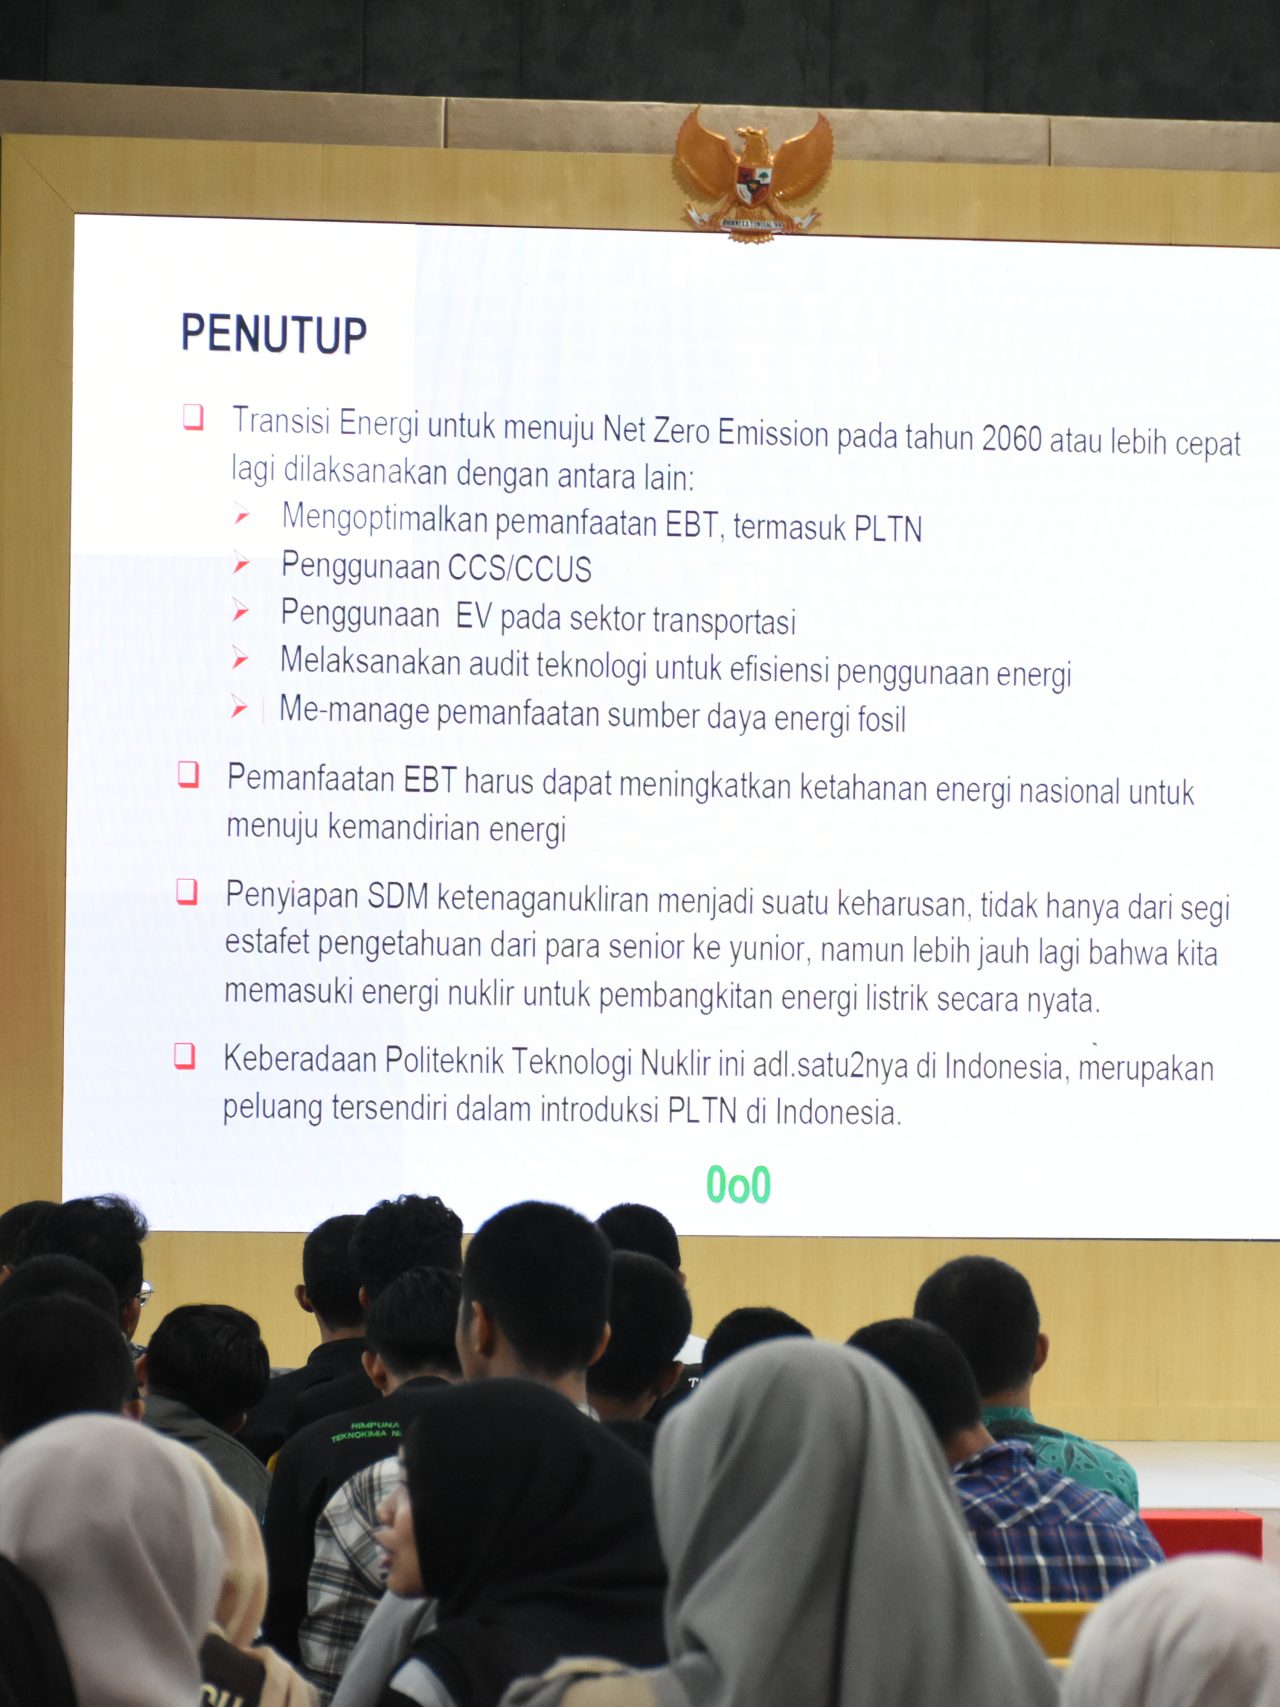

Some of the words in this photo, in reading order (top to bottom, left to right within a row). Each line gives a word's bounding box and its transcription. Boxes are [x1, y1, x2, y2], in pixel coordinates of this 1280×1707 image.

[182, 312, 368, 355] PENUTUP
[232, 404, 329, 434] Transisi
[340, 407, 419, 444] Energi
[428, 410, 496, 439] untuk
[504, 413, 594, 449] menuju
[604, 413, 646, 443] Net
[653, 415, 710, 444] Zero
[719, 416, 829, 448] Emission
[838, 421, 898, 456] pada
[905, 422, 973, 451] tahun
[982, 423, 1042, 452] 2060
[1050, 427, 1102, 454] atau
[1111, 426, 1167, 455] lebih
[1175, 431, 1241, 464] cepat
[232, 452, 275, 488] lagi
[284, 454, 447, 486] dilaksanakan
[456, 458, 549, 494] dengan
[557, 462, 636, 490] antara
[644, 462, 694, 492] lain:
[283, 500, 488, 537] Mengoptimalkan
[495, 507, 657, 541] pemanfaatan
[666, 509, 725, 543] EBT,
[733, 512, 847, 541] termasuk
[855, 514, 922, 543] PLTN
[282, 548, 440, 586] Penggunaan
[448, 552, 592, 584] CCS/CCUS
[282, 596, 440, 634] Penggunaan
[456, 600, 493, 629] EV
[501, 602, 561, 637] pada
[570, 603, 647, 632] sektor
[652, 606, 796, 641] transportasi
[281, 644, 461, 676] Melaksanakan
[469, 649, 530, 677] audit
[536, 649, 647, 687] teknologi
[656, 653, 722, 681] untuk
[730, 654, 829, 683] efisiensi
[837, 663, 989, 692] penggunaan
[996, 660, 1071, 695] energi
[280, 693, 430, 731] Me-manage
[437, 698, 600, 731] pemanfaatan
[607, 700, 701, 729] sumber
[707, 701, 766, 737] daya
[774, 703, 850, 739] energi
[857, 704, 906, 733] fosil
[228, 761, 395, 792] Pemanfaatan
[404, 764, 458, 794] EBT
[465, 765, 534, 795] harus
[542, 767, 612, 803] dapat
[620, 769, 791, 805] meningkatkan
[800, 771, 927, 801] ketahanan
[936, 775, 1011, 810] energi
[1020, 776, 1120, 805] nasional
[1129, 778, 1195, 806] untuk
[227, 810, 318, 846] menuju
[328, 811, 480, 841] kemandirian
[489, 815, 566, 850] energi
[226, 878, 358, 916] Penyiapan
[367, 880, 428, 910] SDM
[438, 882, 649, 919] ketenaganukliran
[658, 887, 754, 921] menjadi
[761, 889, 828, 916] suatu
[838, 888, 972, 921] keharusan,
[980, 890, 1039, 919] tidak
[1046, 891, 1119, 927] hanya
[1128, 892, 1173, 920] dari
[1180, 893, 1230, 928] segi
[225, 926, 310, 955] estafet
[318, 928, 482, 963] pengetahuan
[490, 929, 536, 958] dari
[545, 937, 600, 966] para
[609, 931, 686, 960] senior
[693, 932, 721, 960] ke
[729, 933, 811, 968] yunior,
[821, 941, 904, 963] namun
[913, 935, 970, 964] lebih
[976, 936, 1029, 971] jauh
[1039, 936, 1080, 972] lagi
[1089, 937, 1168, 966] bahwa
[1177, 938, 1218, 967] kita
[225, 975, 353, 1004] memasuki
[362, 977, 439, 1013] energi
[448, 977, 515, 1006] nuklir
[523, 979, 591, 1007] untuk
[599, 980, 773, 1016] pembangkitan
[781, 983, 858, 1018] energi
[866, 983, 929, 1011] listrik
[937, 991, 1019, 1012] secara
[1028, 987, 1100, 1020] nyata.
[224, 1042, 377, 1073] Keberadaan
[386, 1044, 505, 1074] Politeknik
[511, 1046, 632, 1083] Teknologi
[641, 1047, 712, 1077] Nuklir
[719, 1049, 745, 1077] ini
[753, 1049, 908, 1086] adl.satu2nya
[916, 1051, 936, 1079] di
[946, 1051, 1070, 1082] Indonesia,
[1079, 1053, 1214, 1088] merupakan
[223, 1090, 323, 1127] peluang
[331, 1093, 447, 1121] tersendiri
[456, 1093, 531, 1122] dalam
[541, 1095, 658, 1123] introduksi
[669, 1095, 737, 1124] PLTN
[746, 1096, 766, 1125] di
[776, 1096, 901, 1126] Indonesia.
